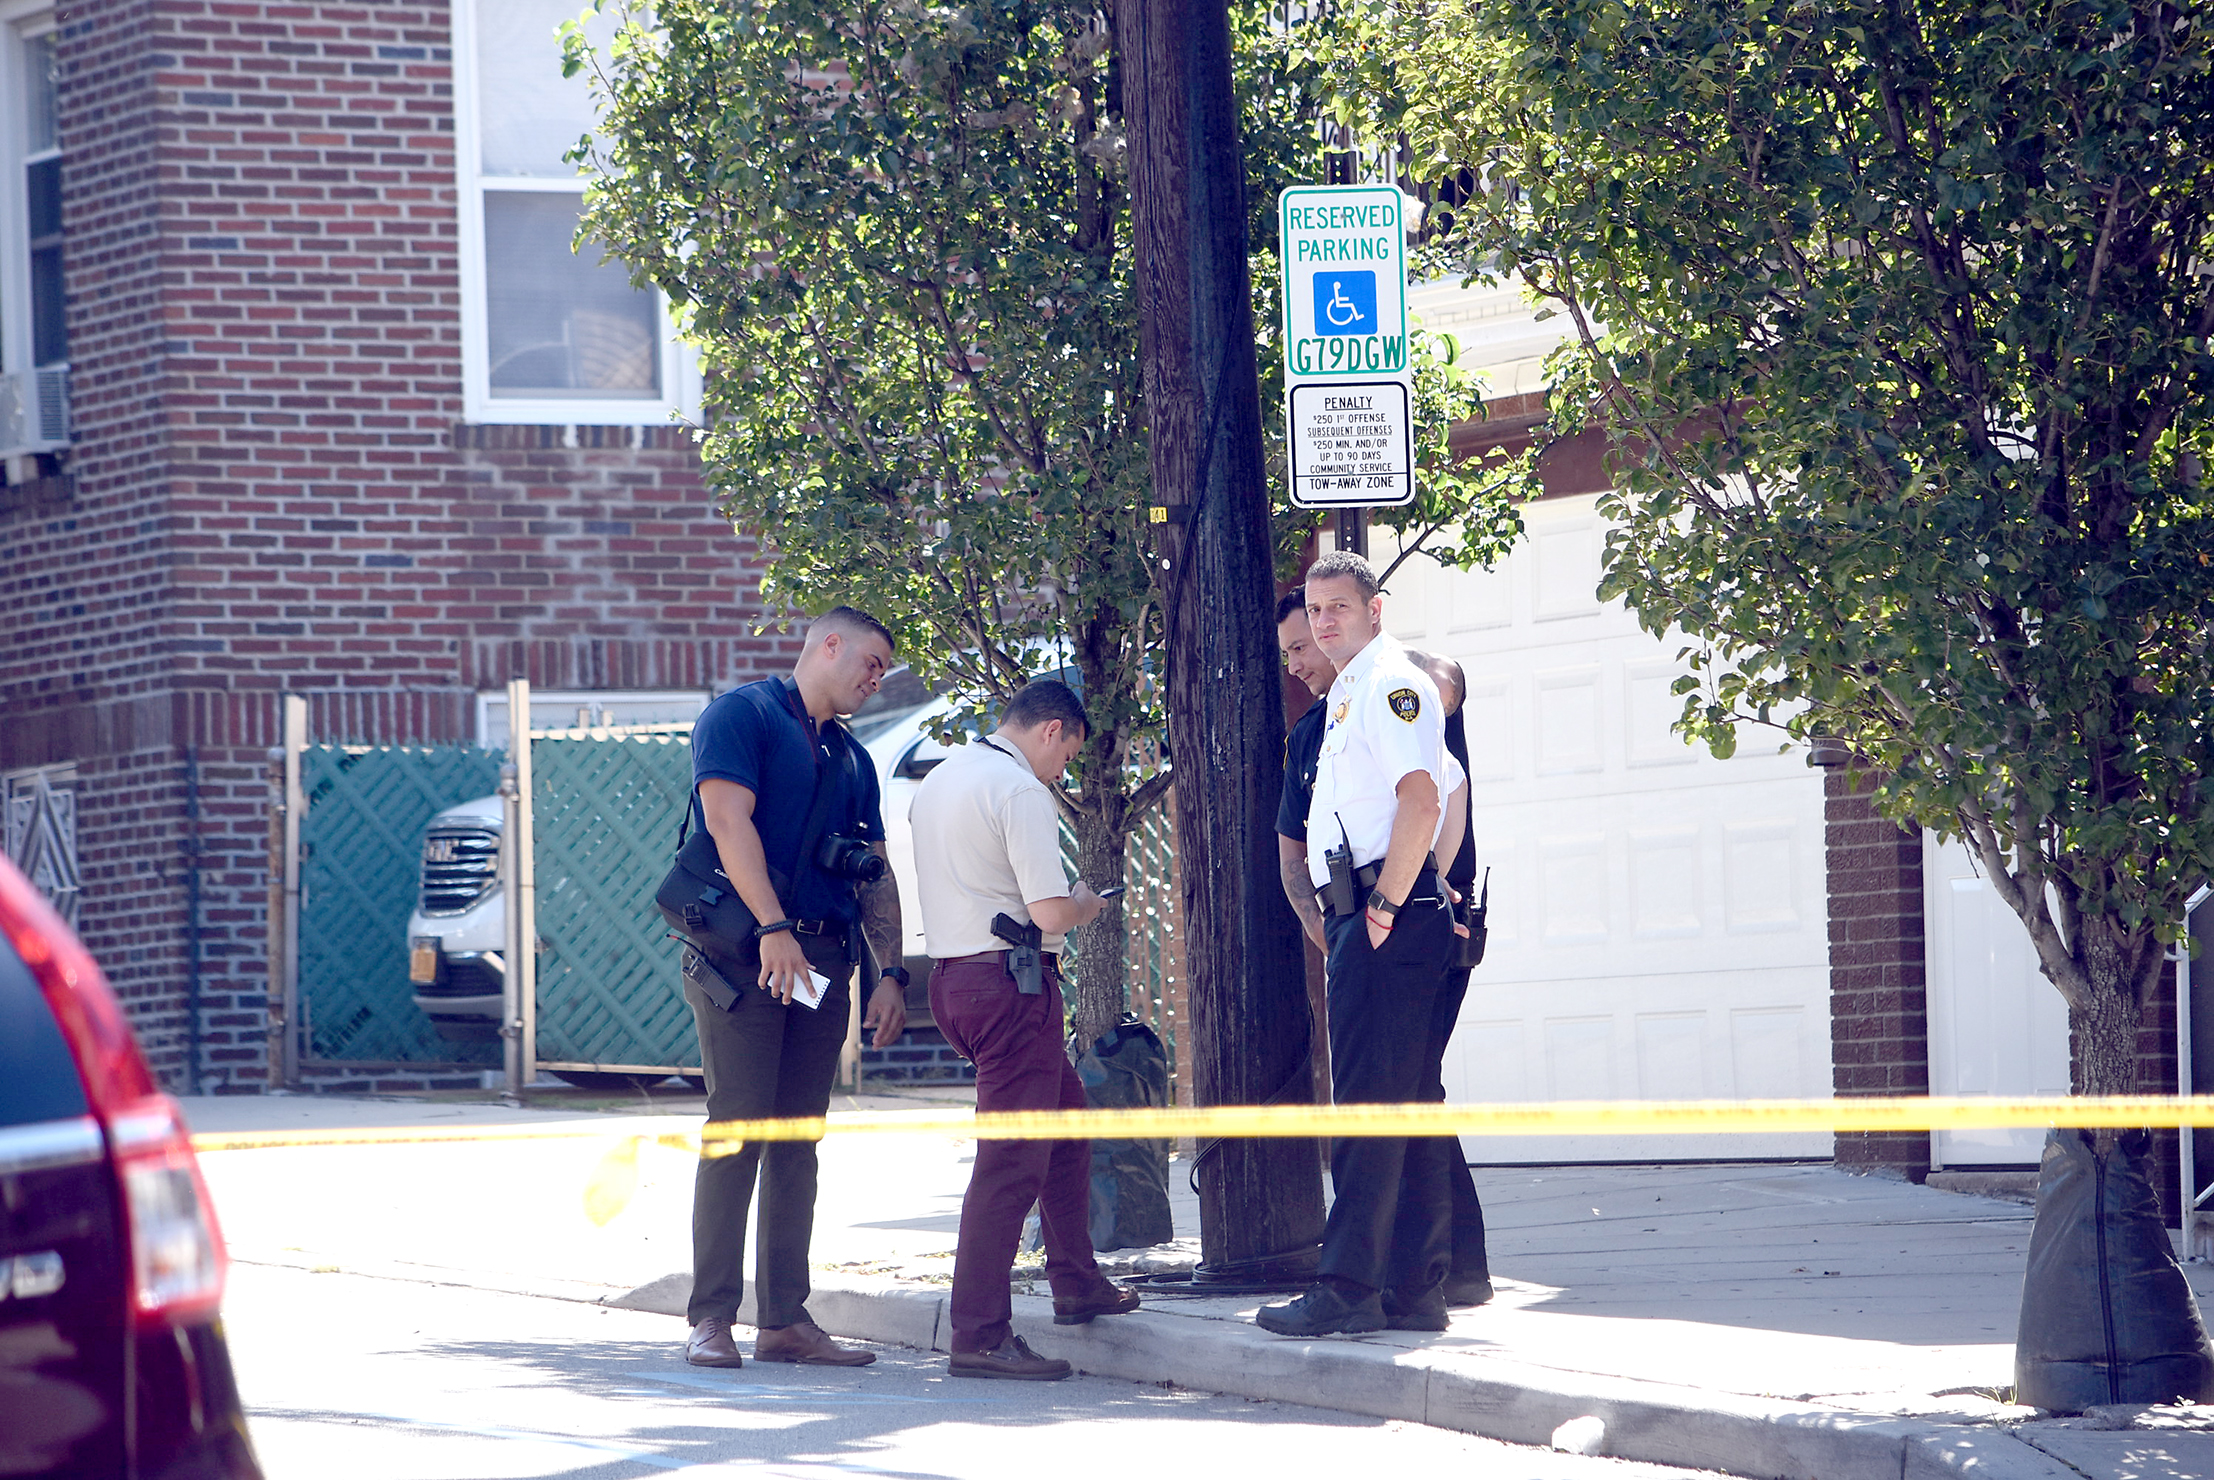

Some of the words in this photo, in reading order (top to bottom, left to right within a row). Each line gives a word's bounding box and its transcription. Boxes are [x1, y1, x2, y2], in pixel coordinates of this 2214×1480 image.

[1290, 205, 1395, 230] RESERVED
[1298, 237, 1389, 262] PARKING
[1297, 336, 1402, 372] G79DGW
[1325, 396, 1373, 409] PENALTY
[1313, 414, 1333, 424] $250
[1348, 413, 1386, 423] OFFENSE
[1307, 426, 1353, 437] SUBSEQUENT
[1356, 425, 1393, 435] OFFENSES
[1313, 440, 1333, 449] $250
[1336, 440, 1352, 449] MIN.
[1355, 438, 1388, 449] AND/OR
[1320, 452, 1331, 461] UP
[1334, 452, 1344, 461] TO
[1347, 451, 1358, 461] 90
[1362, 451, 1382, 460] DAYS
[1310, 464, 1356, 474] COMMUNITY
[1359, 463, 1393, 472] SERVICE
[1309, 477, 1362, 490] TOW-AWAY
[1366, 476, 1394, 488] ZONE
